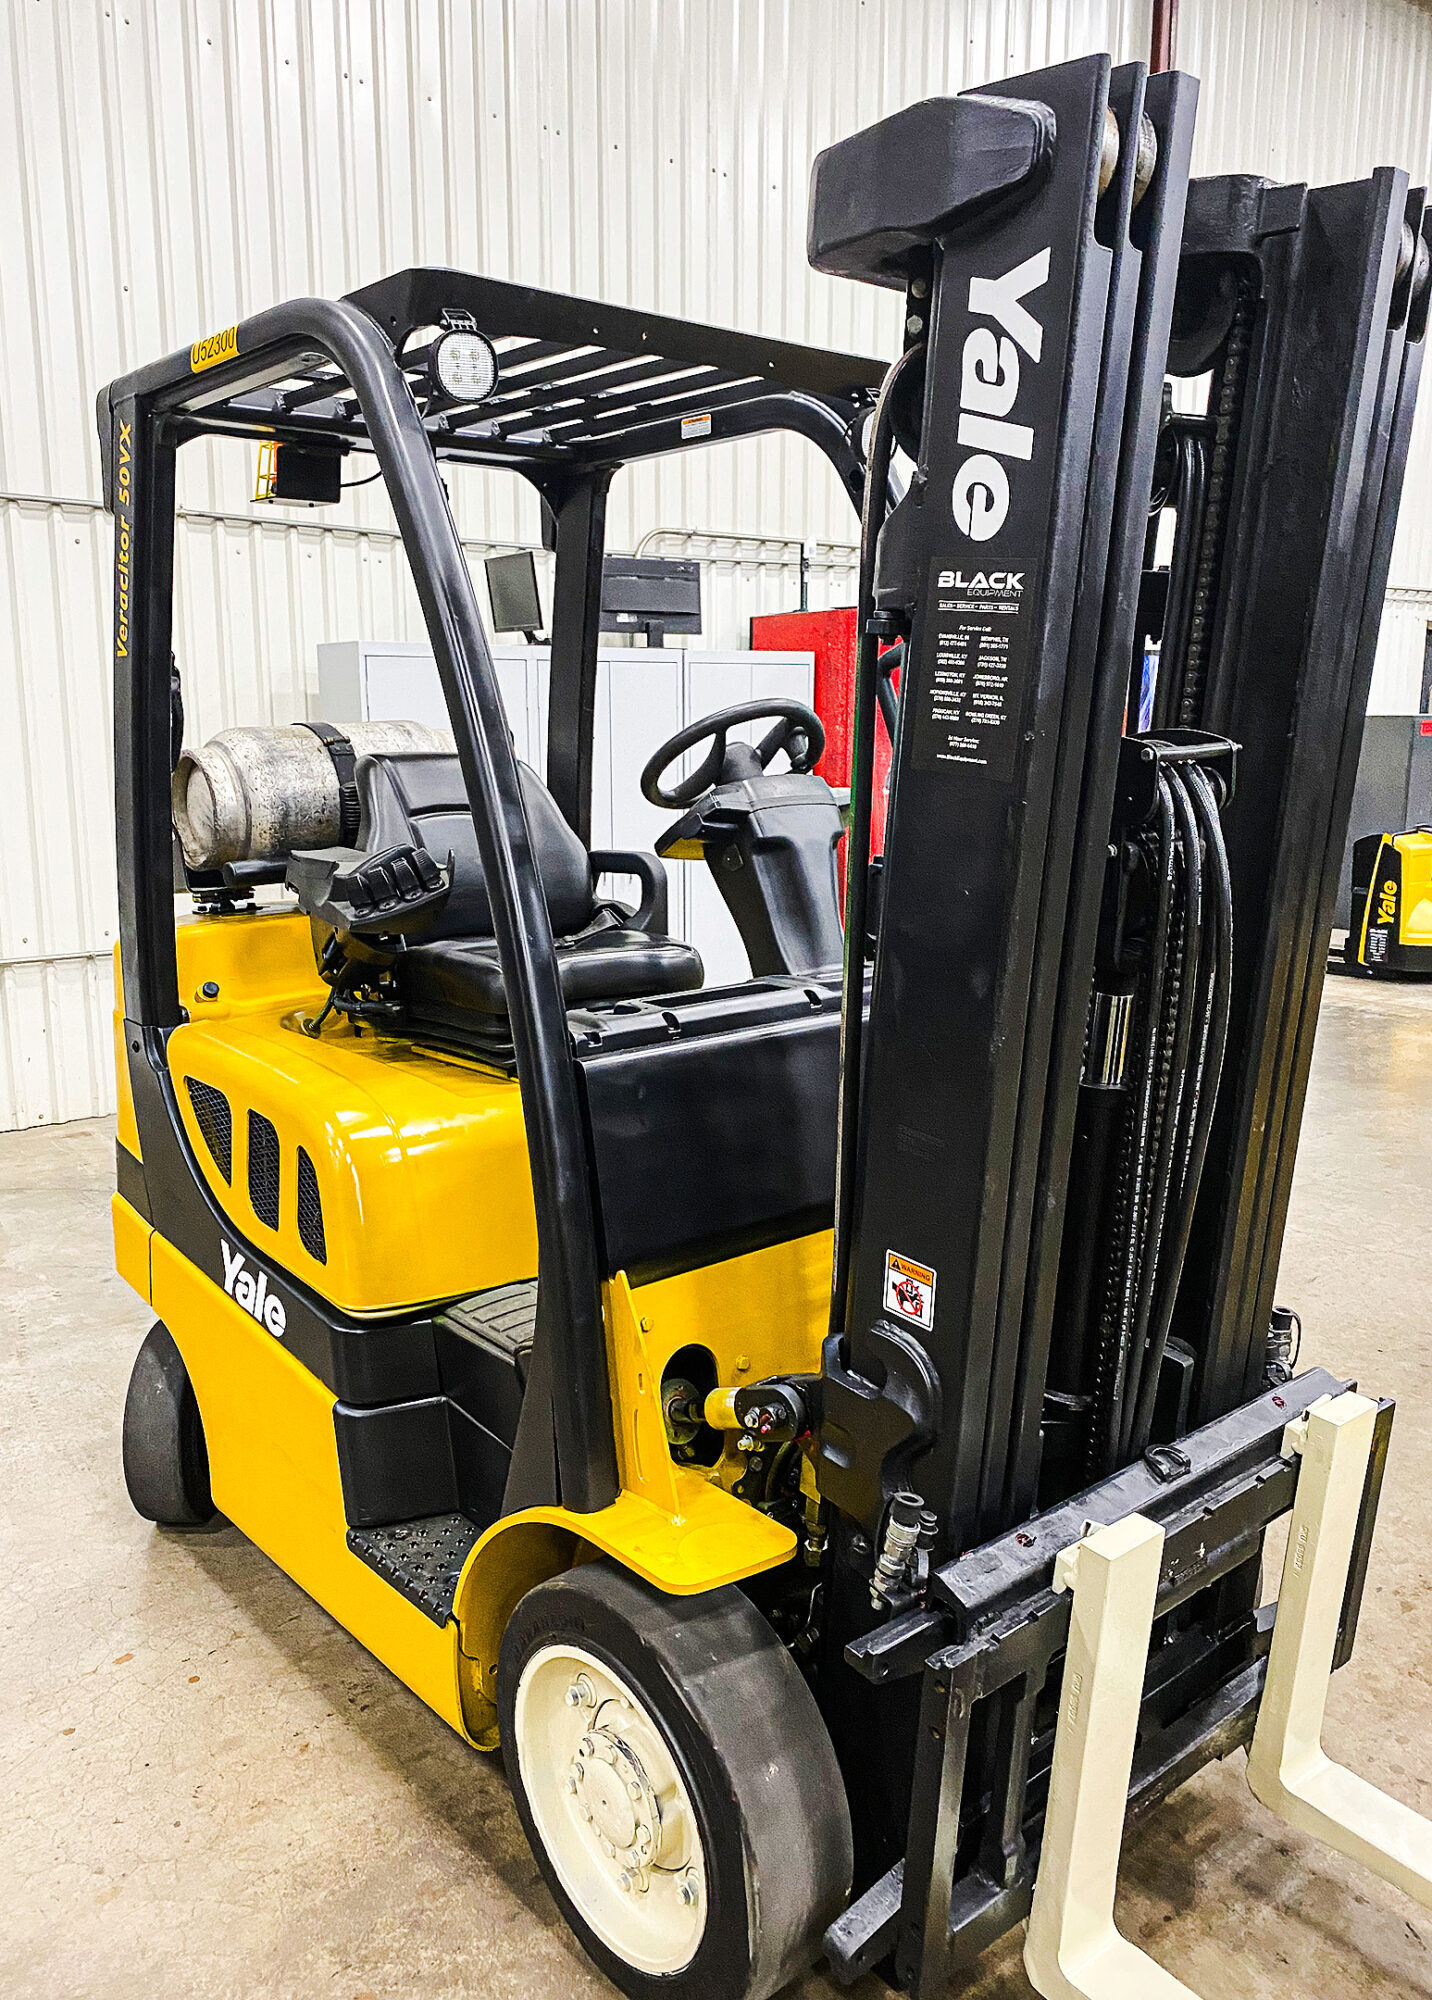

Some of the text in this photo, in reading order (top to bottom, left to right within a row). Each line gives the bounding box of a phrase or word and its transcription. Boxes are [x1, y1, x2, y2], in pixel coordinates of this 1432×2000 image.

[191, 327, 236, 366] U52300
[952, 246, 1050, 541] Yale
[115, 421, 132, 657] Veracitor 50VX
[938, 570, 1025, 590] BLACK
[967, 588, 1023, 598] EQUIPMENT
[1377, 880, 1398, 924] Yale
[220, 1237, 288, 1338] Yale
[902, 1264, 931, 1282] WARNING
